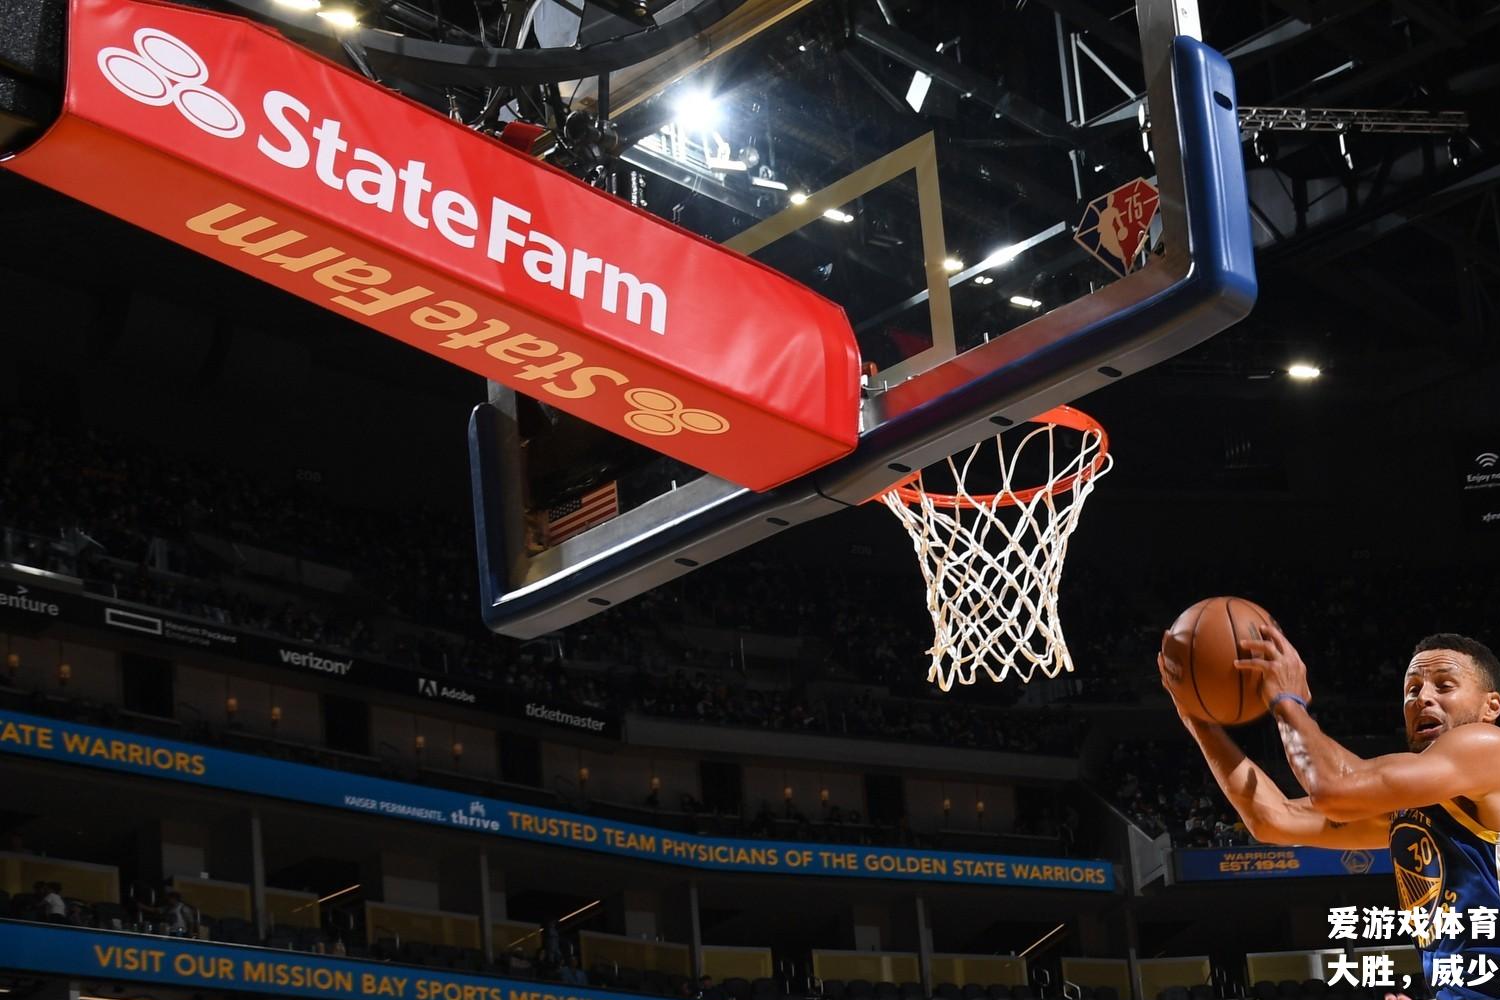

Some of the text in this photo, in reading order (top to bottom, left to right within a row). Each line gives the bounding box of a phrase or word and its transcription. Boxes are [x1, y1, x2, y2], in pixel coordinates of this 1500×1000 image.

[1125, 193, 1143, 223] 75
[279, 649, 346, 676] verizon
[441, 687, 475, 704] Adobe
[525, 703, 607, 732] ticketmaster
[62, 731, 206, 776] WARRIORS
[344, 796, 1106, 885] KAISER thrive TRUSTED TEAM PHYSICIANS OF THE GOLDEN STATE WARRIORS
[1407, 837, 1432, 872] 30
[1223, 851, 1295, 862] WARRIORS
[94, 944, 165, 973] VISIT
[173, 952, 235, 981] OUR
[243, 960, 353, 992] MISSION
[361, 973, 407, 999] BAY
